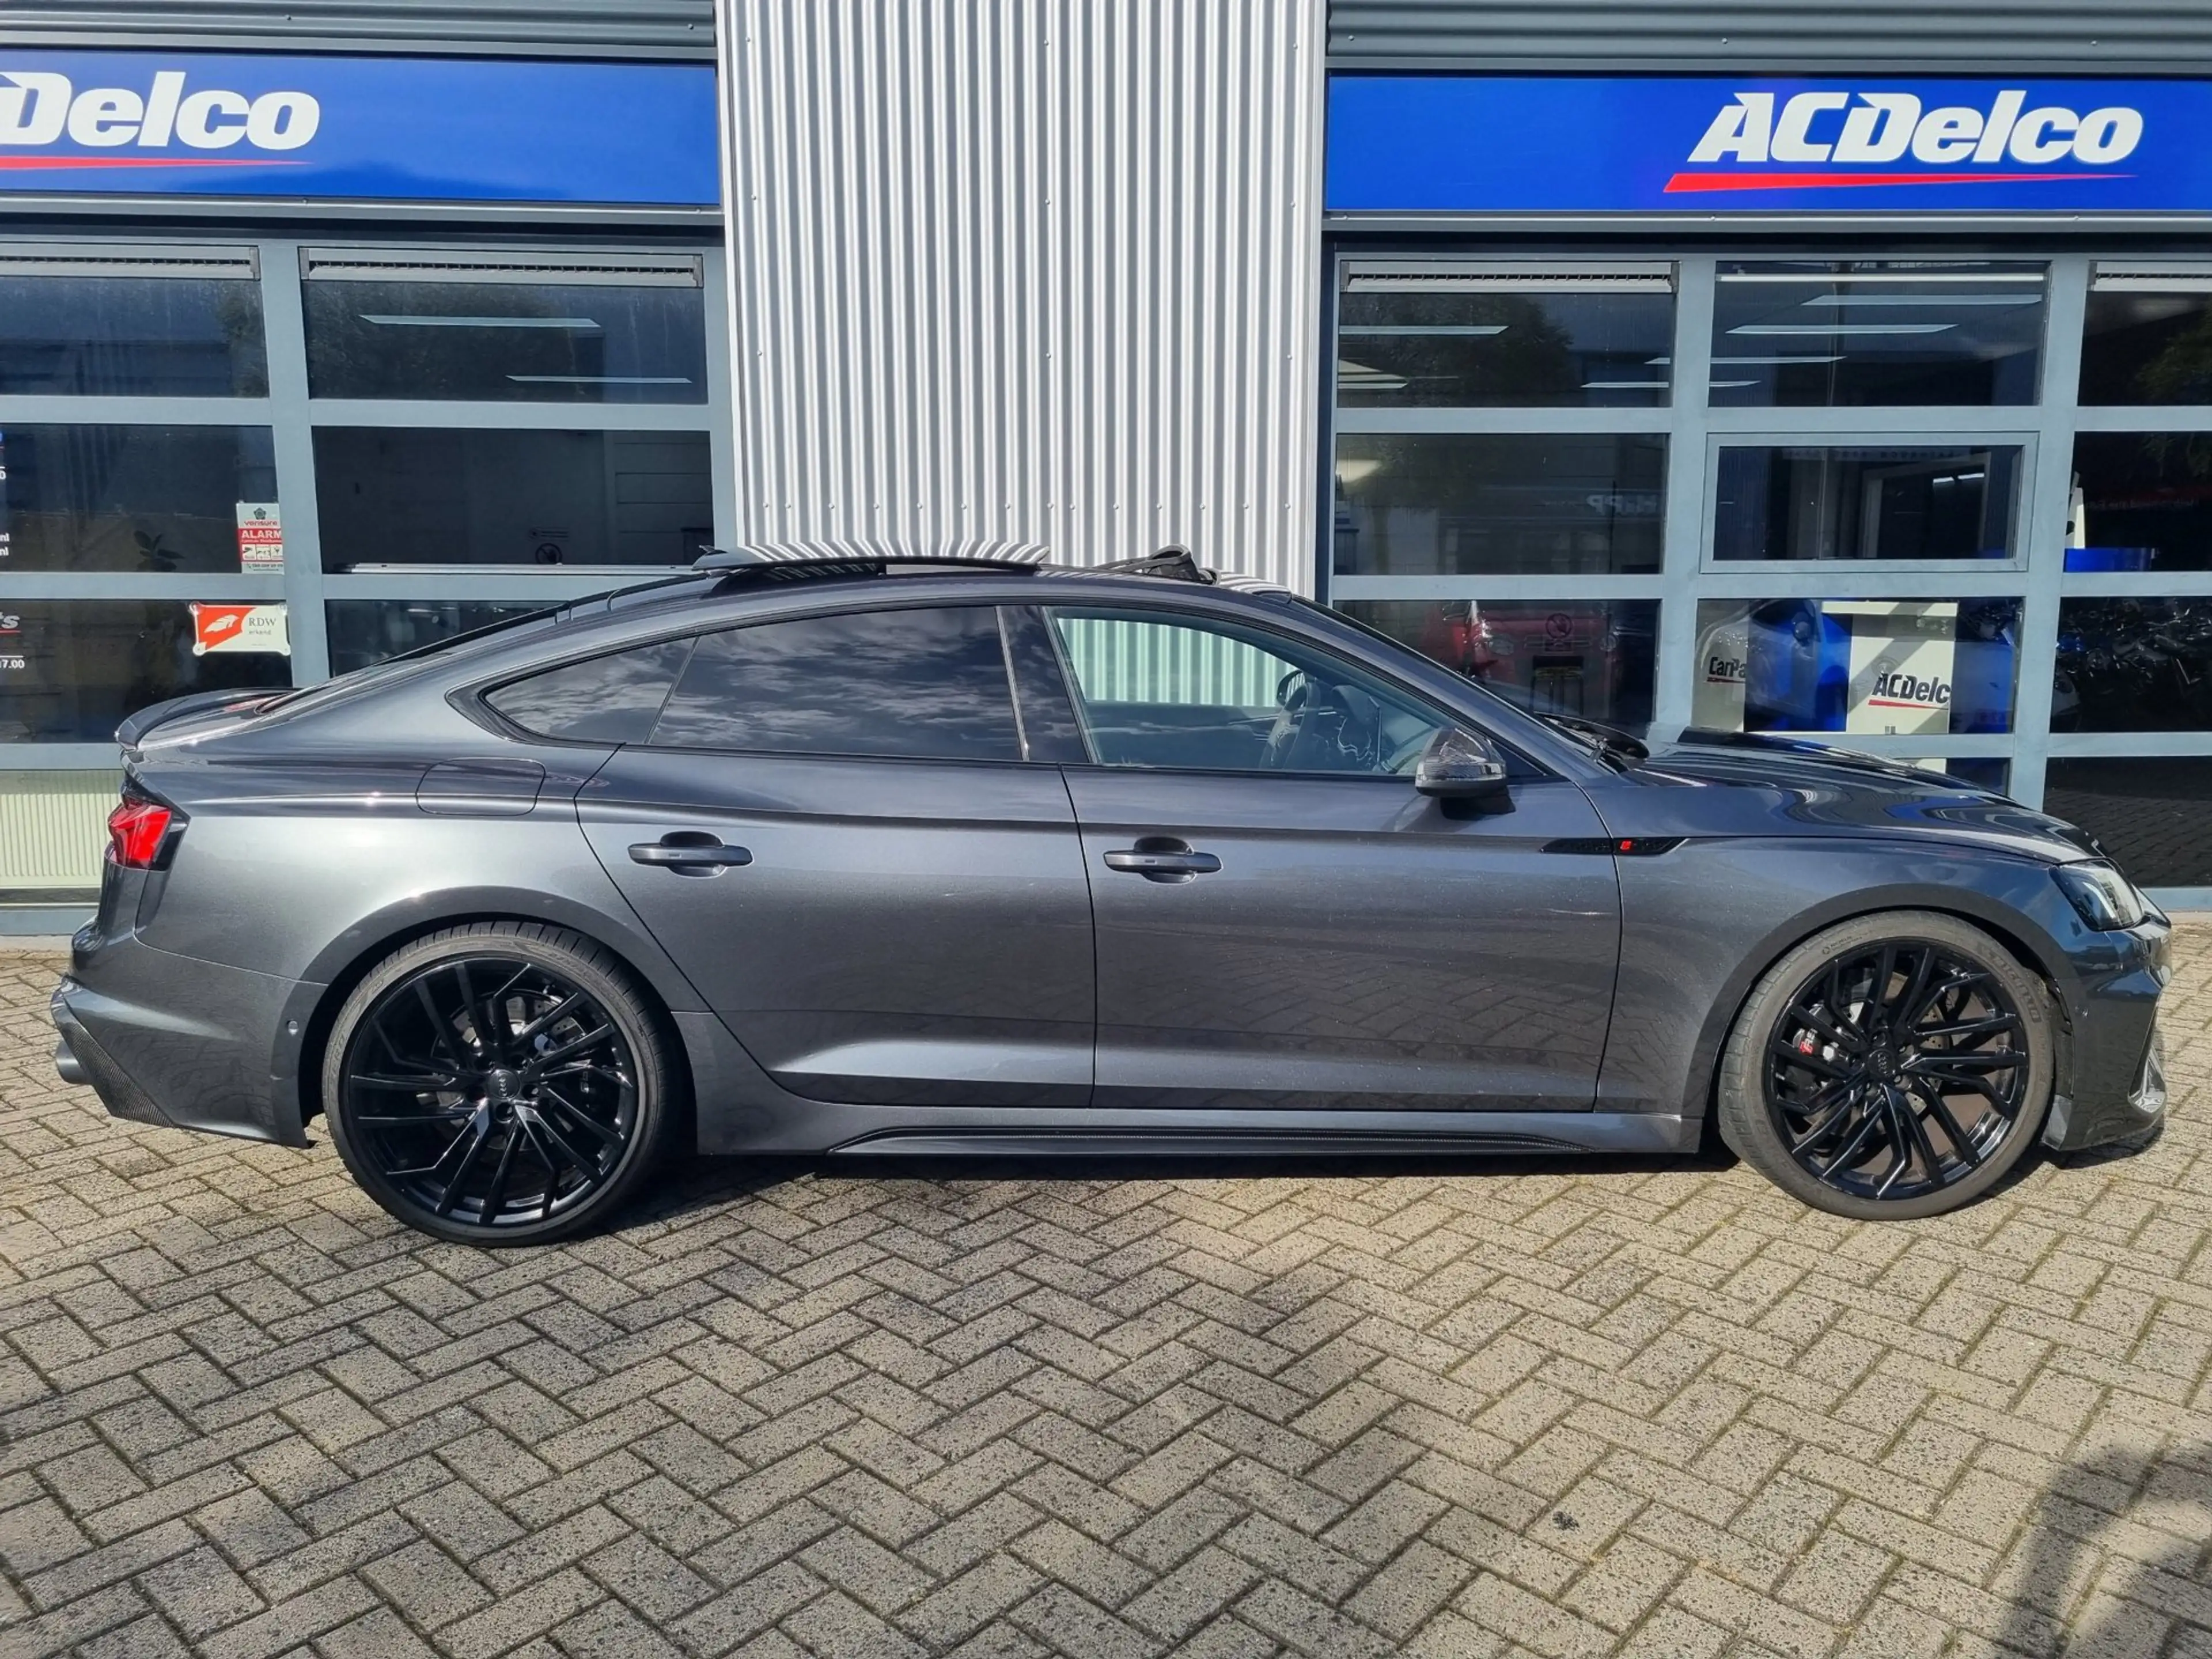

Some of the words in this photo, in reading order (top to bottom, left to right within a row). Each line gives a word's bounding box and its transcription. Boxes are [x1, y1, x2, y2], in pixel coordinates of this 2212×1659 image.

[1687, 90, 2143, 164] ACDelco
[248, 617, 276, 627] RDW
[1872, 673, 1952, 703] ACDelc
